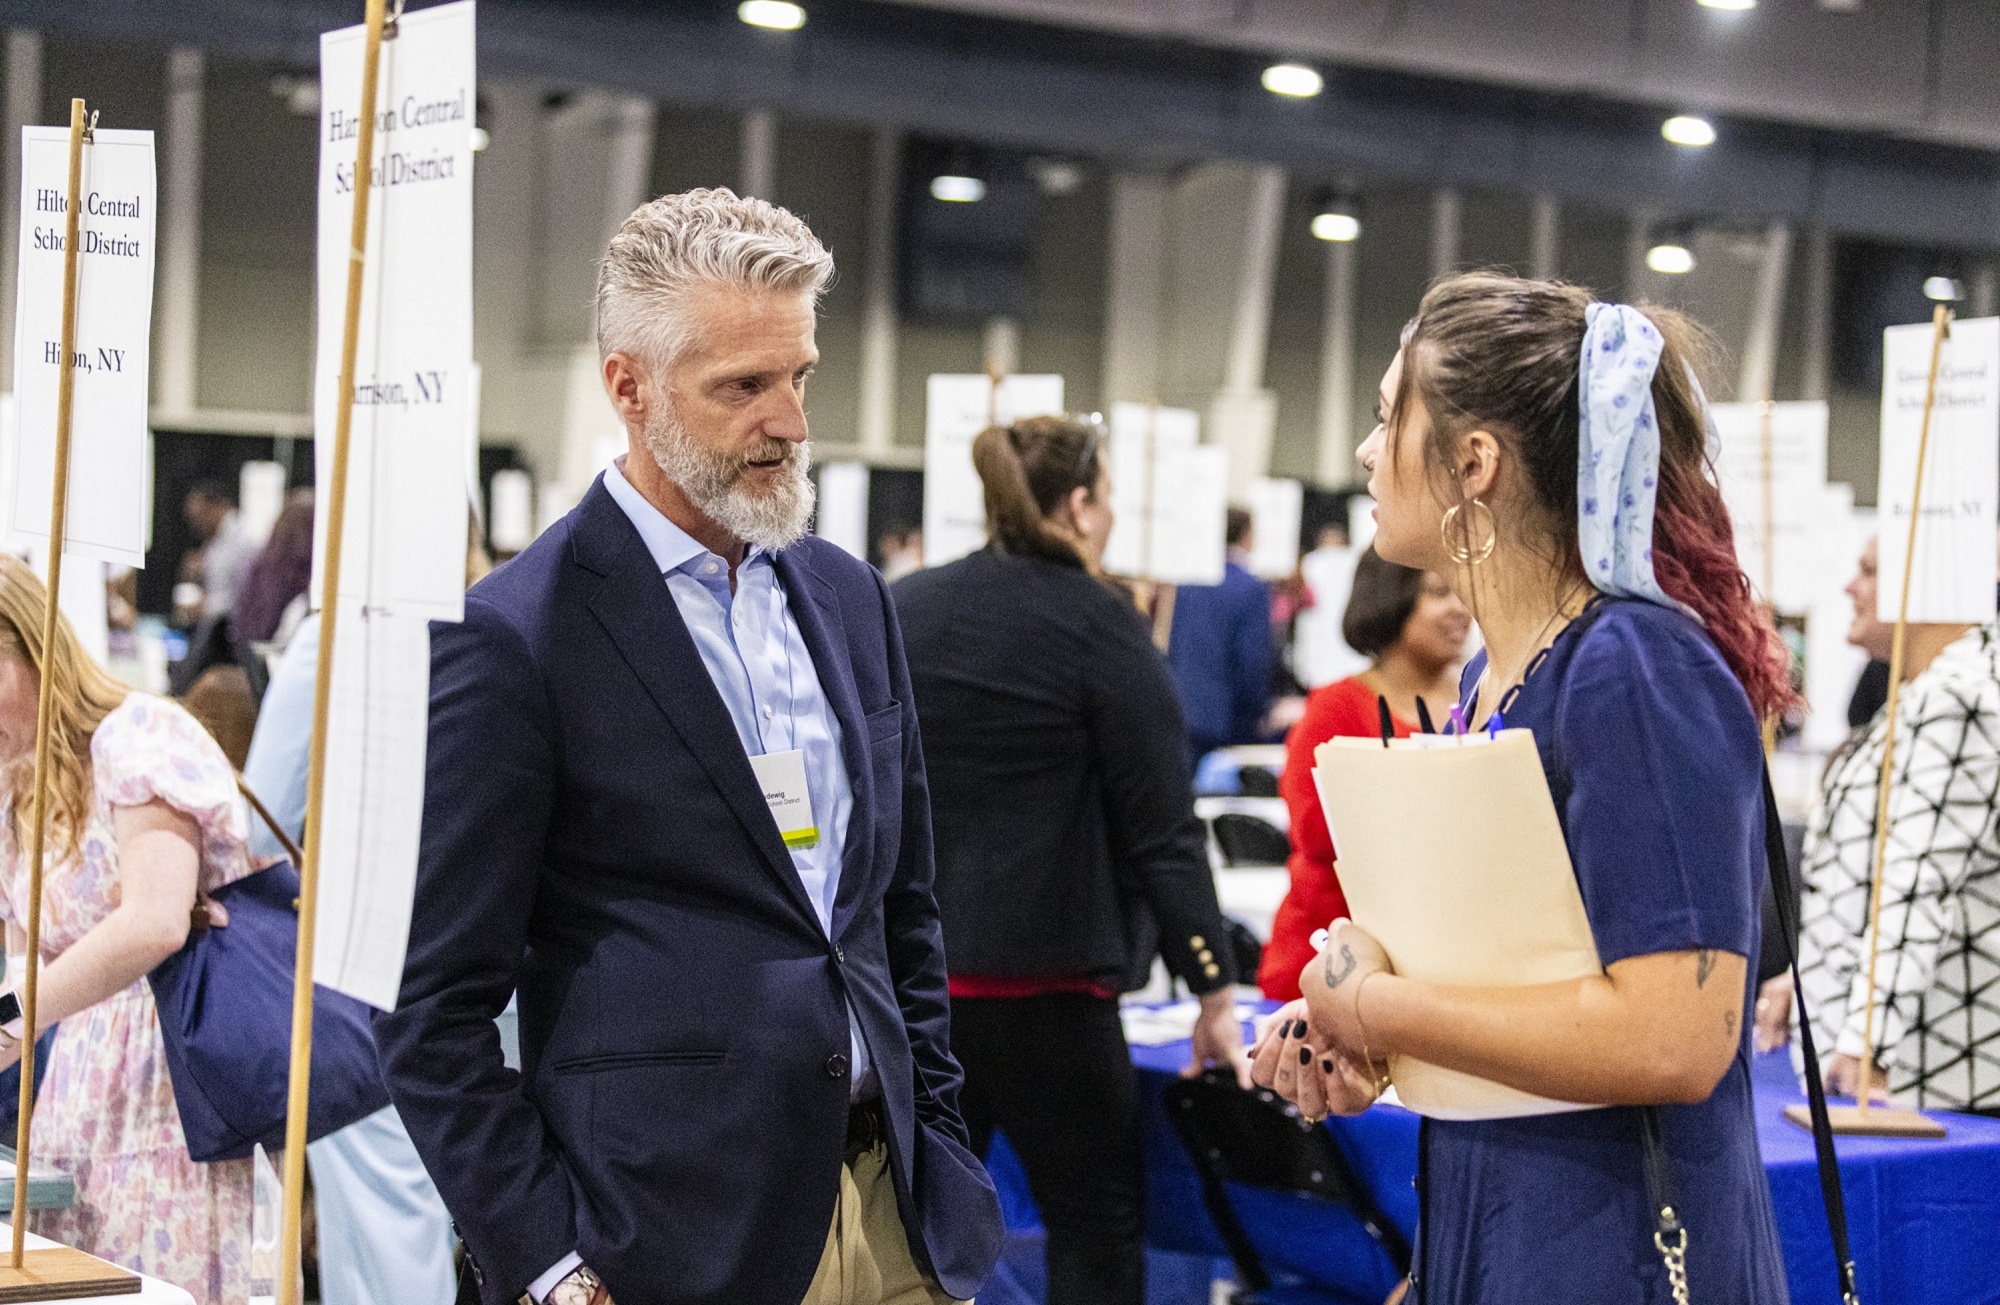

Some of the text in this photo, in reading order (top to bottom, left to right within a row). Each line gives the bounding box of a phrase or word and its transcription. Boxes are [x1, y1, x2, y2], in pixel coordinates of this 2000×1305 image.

[329, 88, 465, 142] Haron Central
[390, 150, 455, 186] District
[87, 192, 140, 218] Central
[85, 230, 140, 258] District
[97, 347, 126, 373] NY
[414, 370, 448, 403] NY
